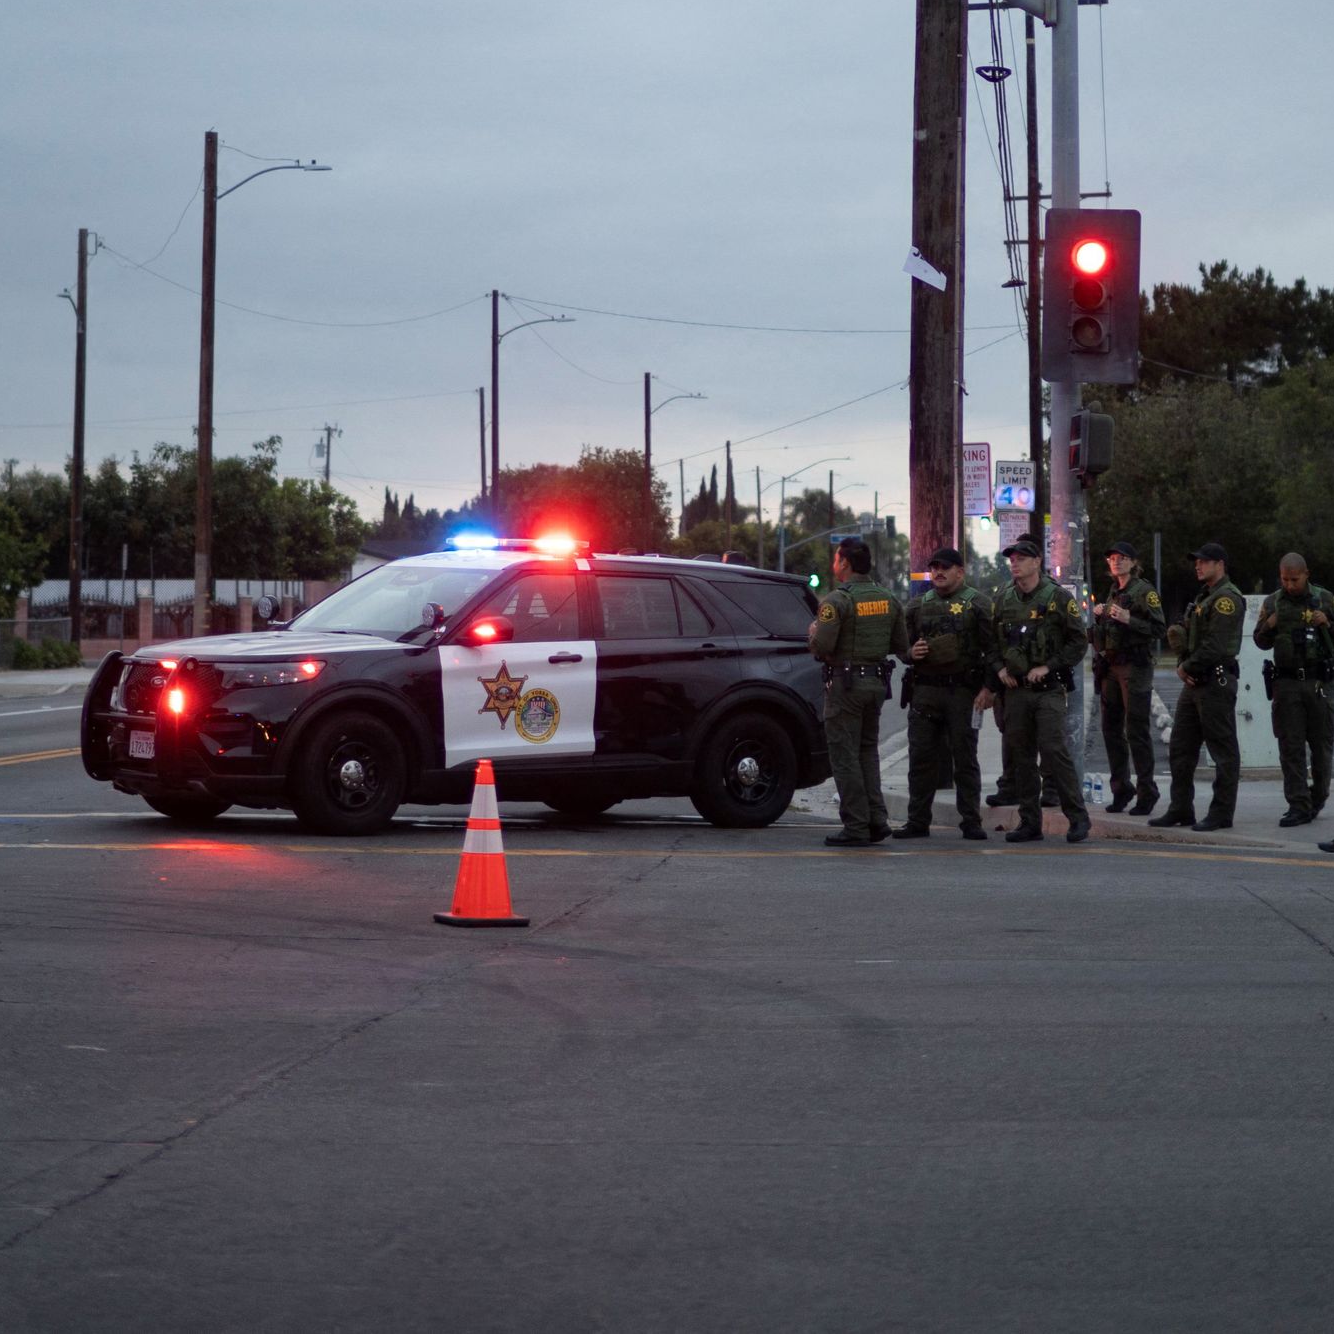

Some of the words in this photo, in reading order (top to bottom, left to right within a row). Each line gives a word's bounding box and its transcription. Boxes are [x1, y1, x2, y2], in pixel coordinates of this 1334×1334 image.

[963, 449, 986, 462] KING
[999, 466, 1033, 475] SPEED
[1002, 477, 1028, 485] LIMIT
[998, 486, 1031, 506] 40
[856, 600, 890, 616] SHERIFF
